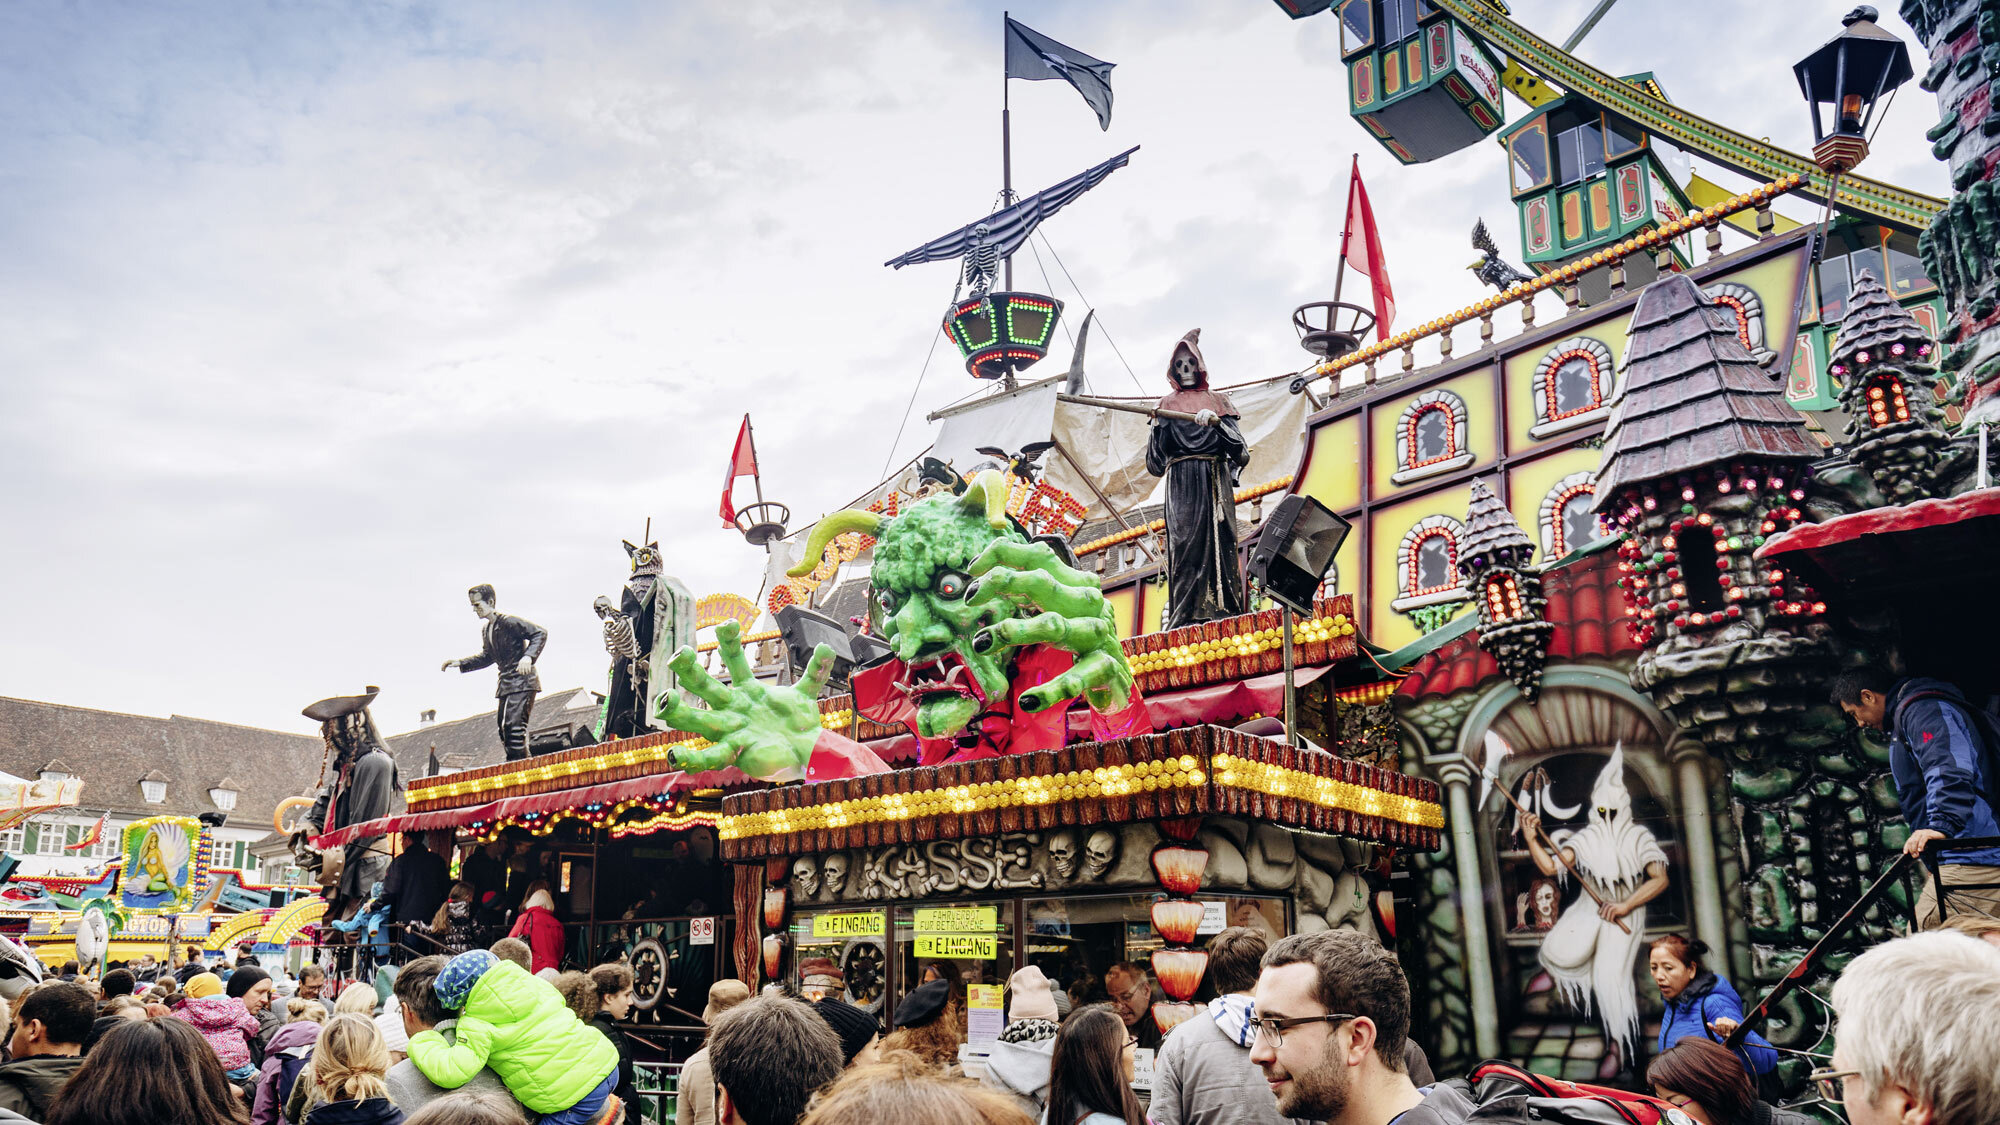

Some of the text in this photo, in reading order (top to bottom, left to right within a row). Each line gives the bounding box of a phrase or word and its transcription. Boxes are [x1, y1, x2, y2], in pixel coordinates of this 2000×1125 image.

[863, 833, 1046, 899] KASSE
[932, 909, 980, 921] FAHRVERBOT
[832, 916, 880, 934] EINGANG
[936, 919, 984, 931] BETRUNKENE
[935, 937, 991, 956] EINGANG
